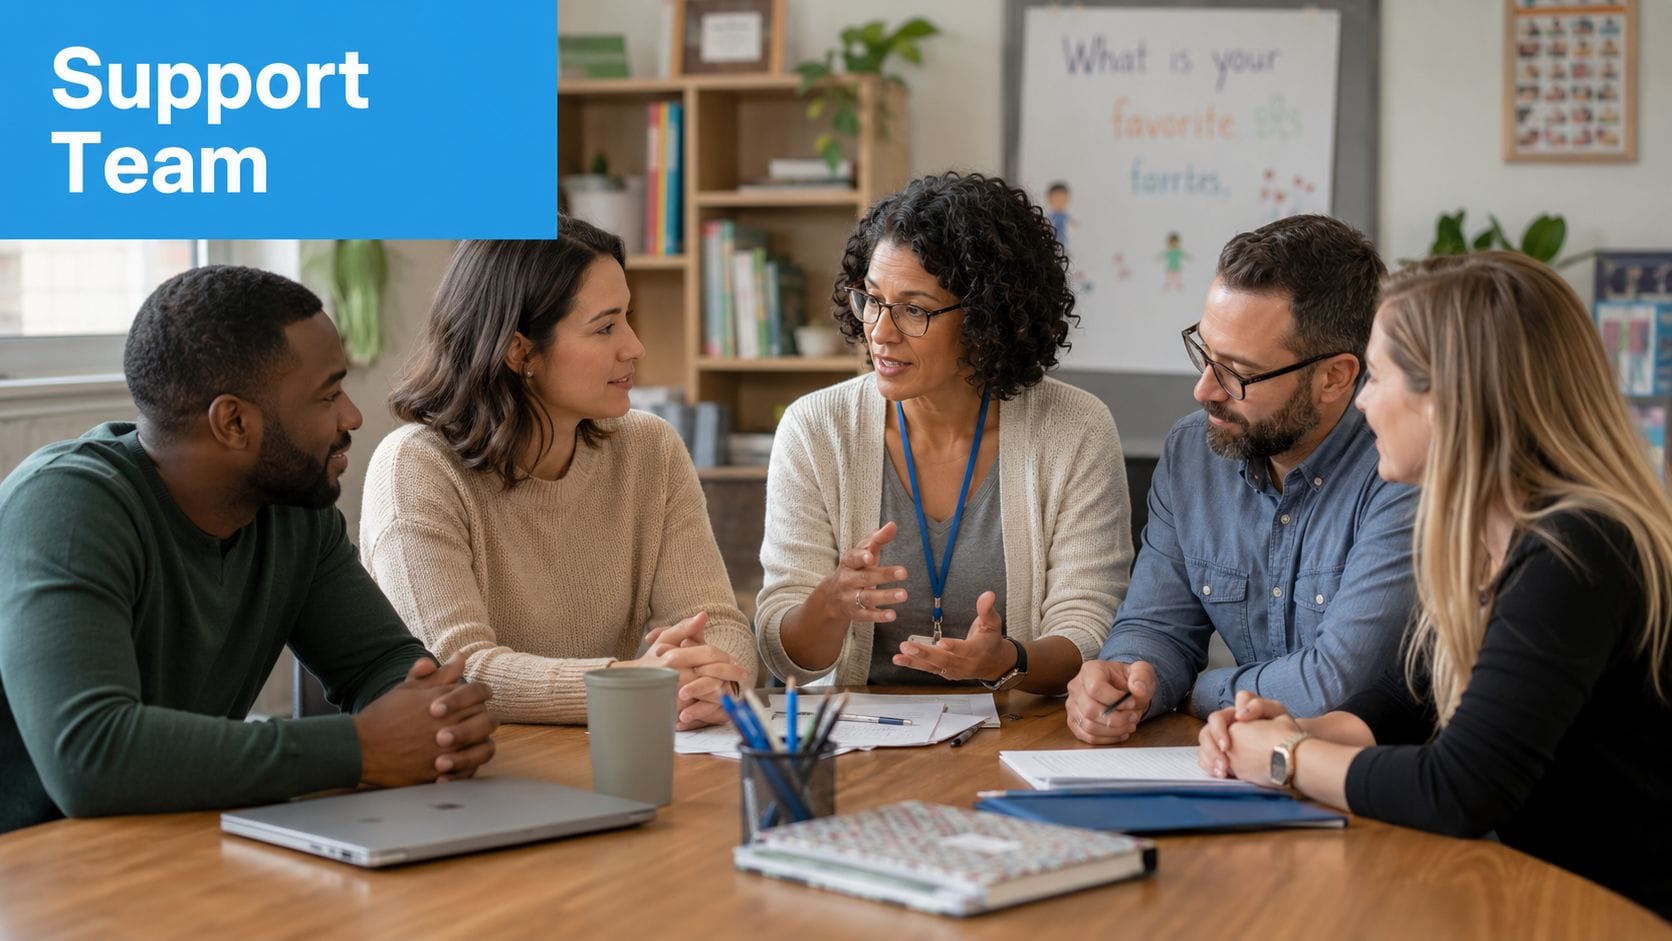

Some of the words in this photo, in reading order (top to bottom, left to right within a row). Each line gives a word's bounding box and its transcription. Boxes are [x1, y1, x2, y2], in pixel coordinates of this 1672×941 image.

[1061, 34, 1147, 76] What
[1169, 47, 1194, 73] is
[1212, 47, 1282, 93] your
[1112, 96, 1235, 140] favorite
